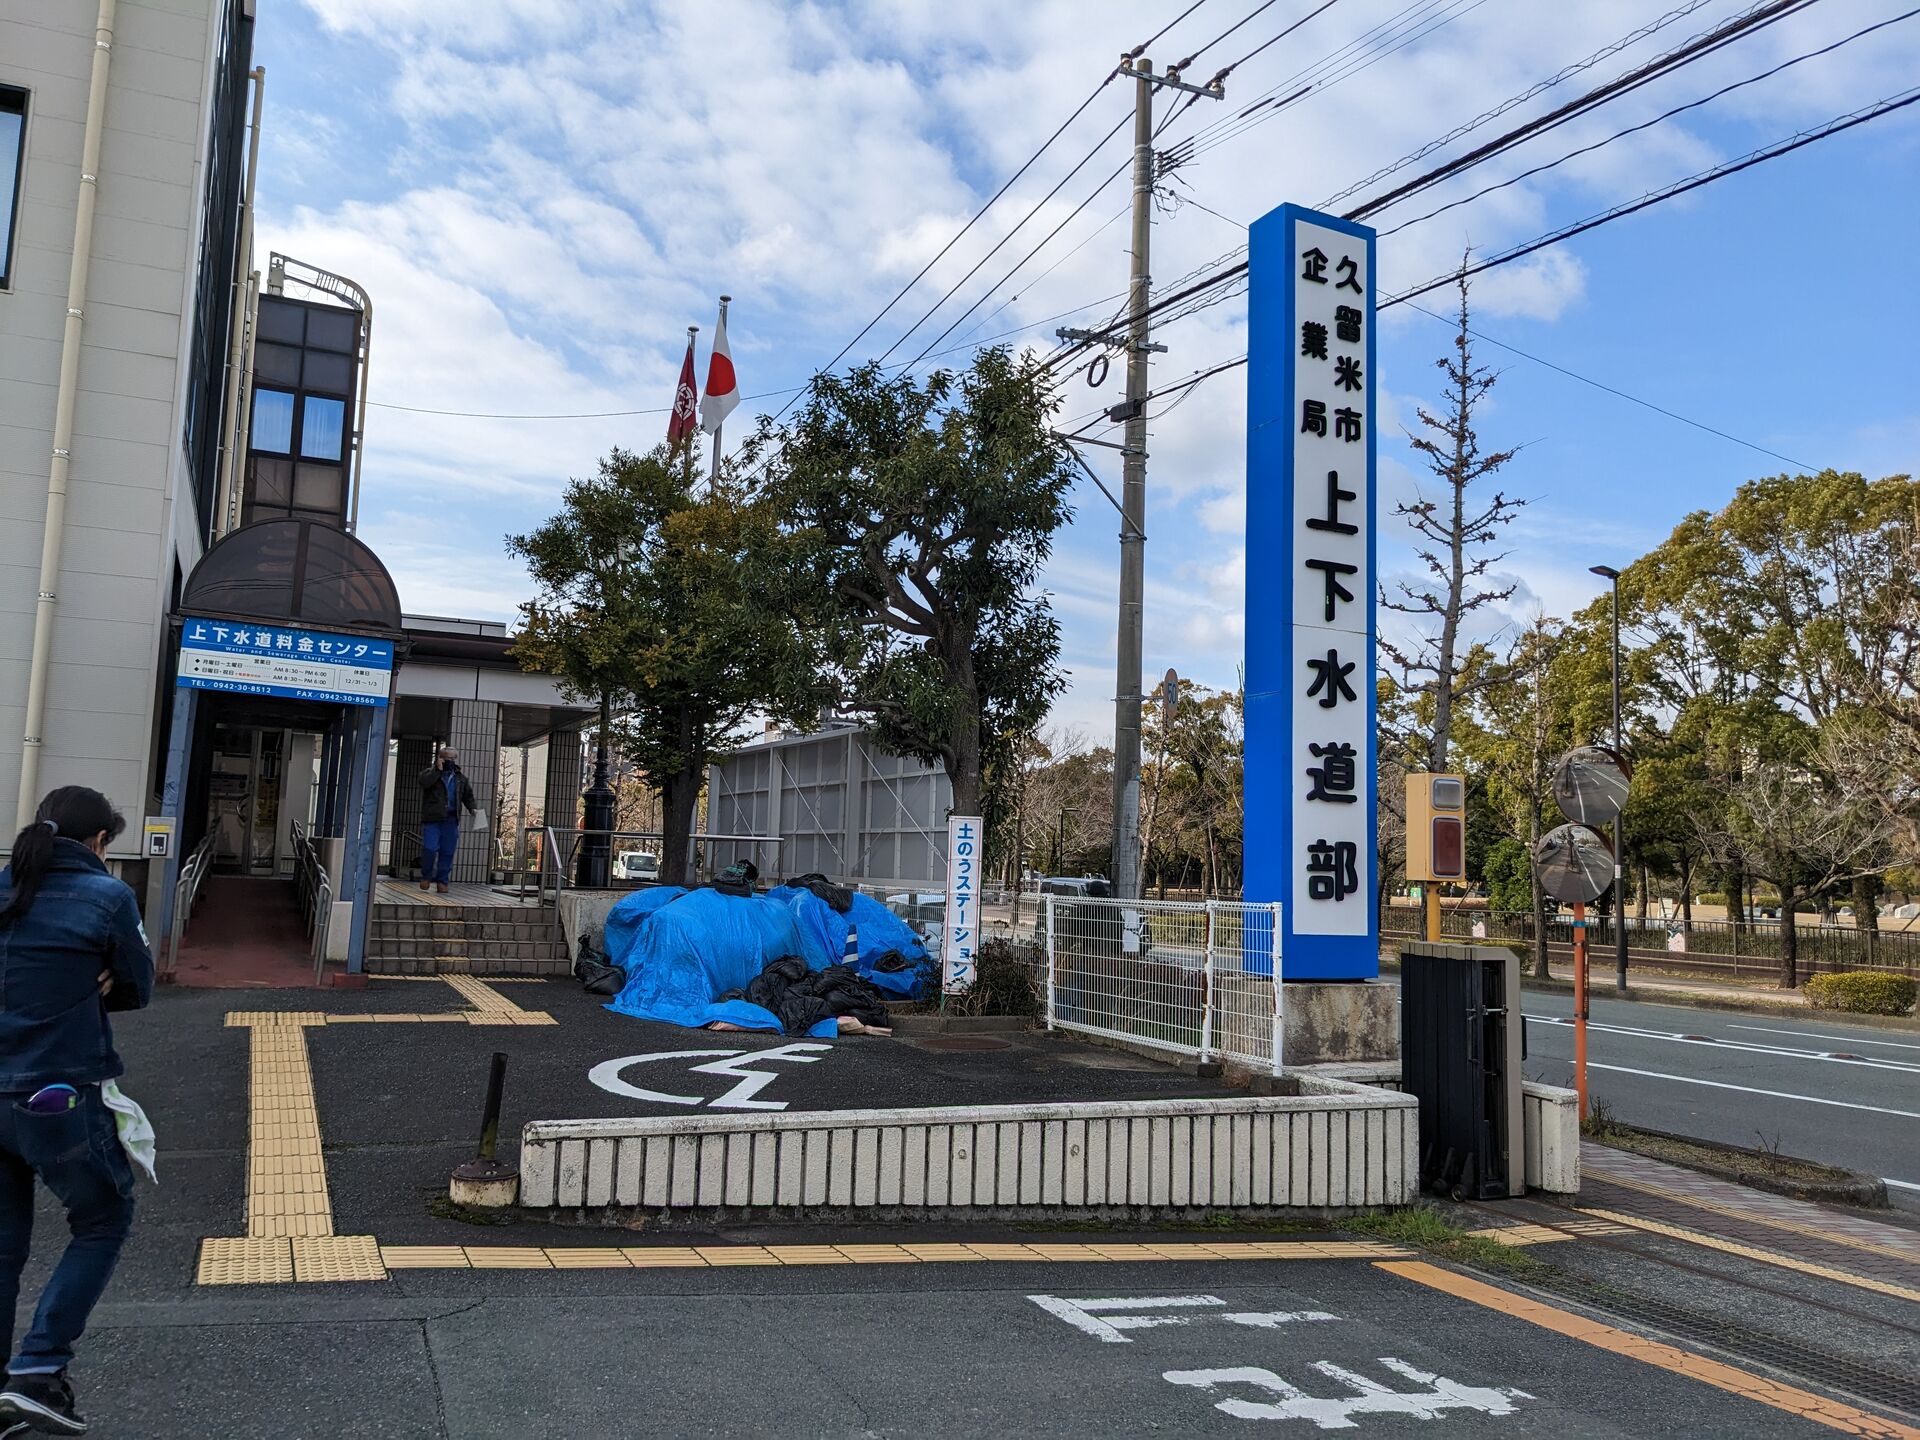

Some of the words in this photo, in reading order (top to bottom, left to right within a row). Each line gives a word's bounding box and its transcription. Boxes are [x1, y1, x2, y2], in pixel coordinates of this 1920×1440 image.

[1301, 247, 1328, 437] 企業局
[1335, 255, 1363, 443] 久留米市
[189, 625, 387, 657] 上下水道料金センター
[1168, 682, 1177, 705] 50
[1306, 470, 1359, 902] 上下水道部
[953, 823, 974, 978] 土のうステーション
